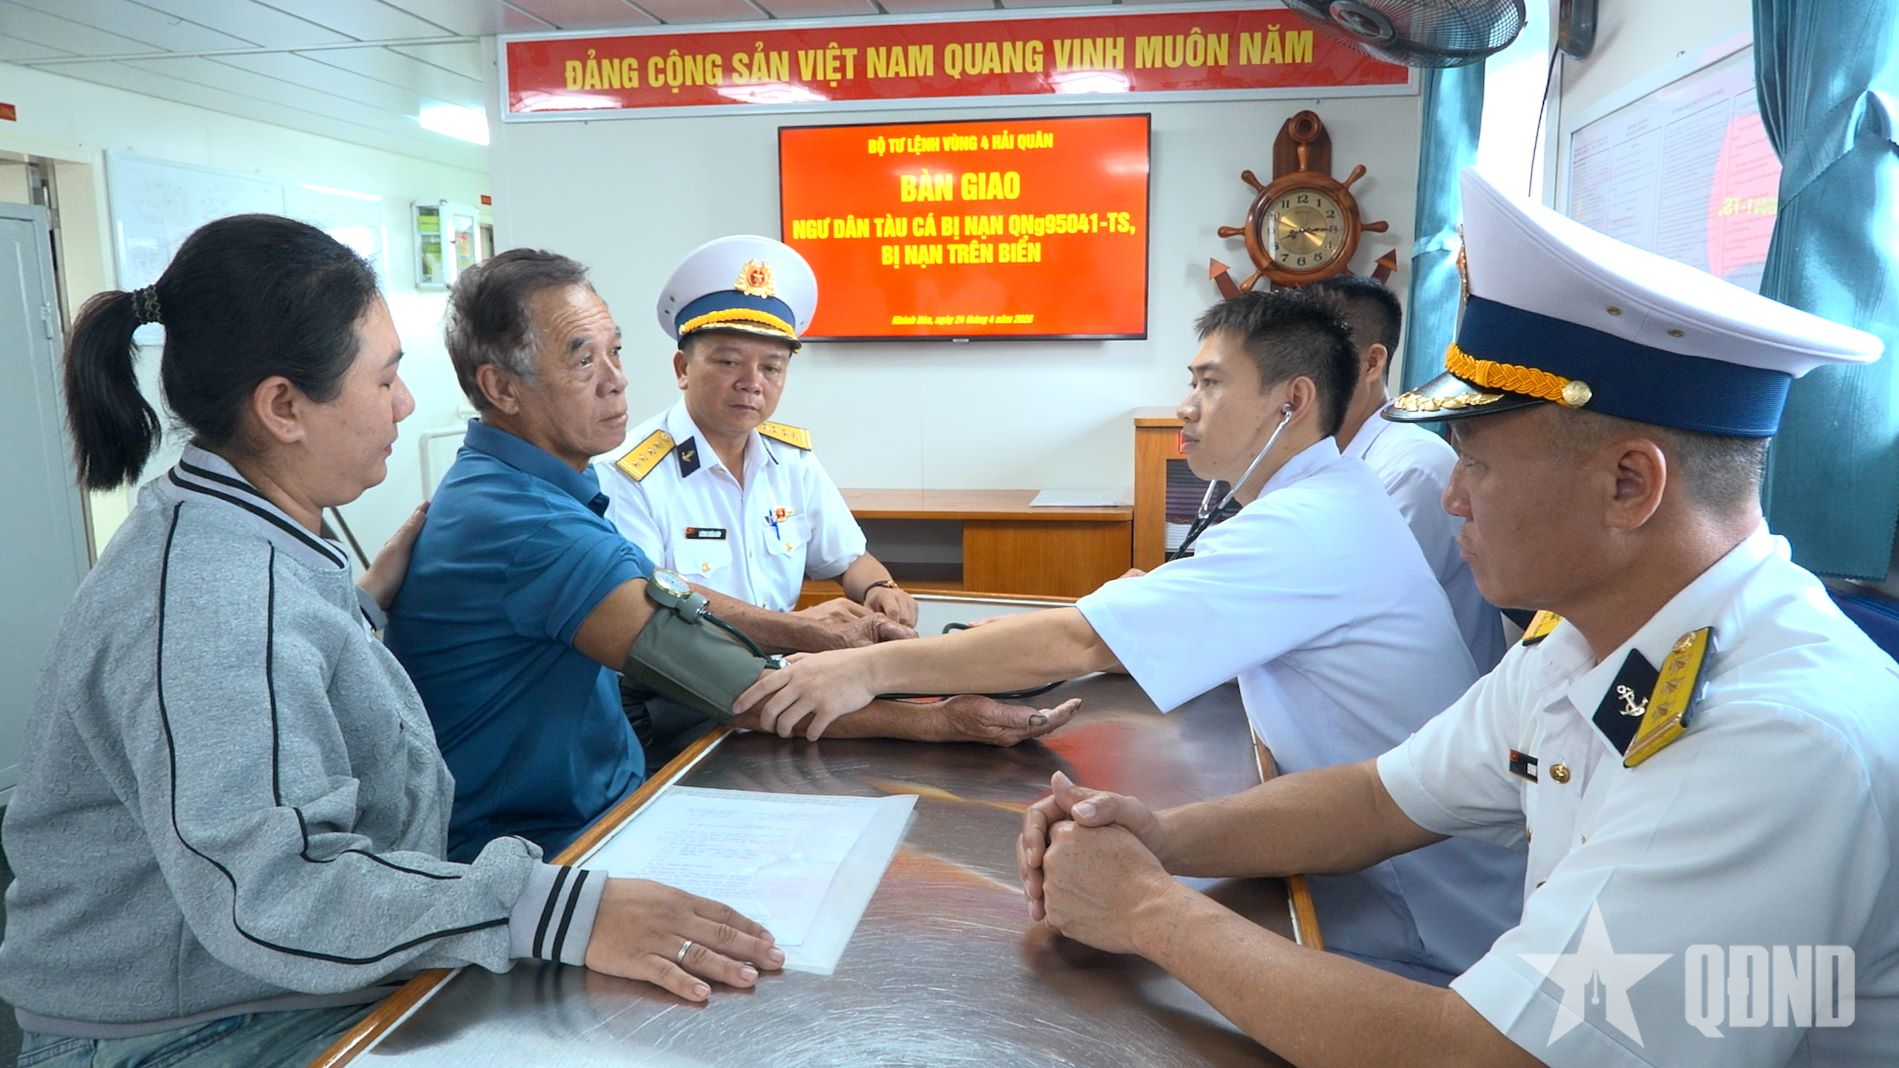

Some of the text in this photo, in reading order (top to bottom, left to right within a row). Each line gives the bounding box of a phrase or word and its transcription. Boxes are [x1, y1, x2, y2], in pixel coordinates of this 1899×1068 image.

[565, 24, 1314, 94] ĐẢNG CỘNG SẢN VIỆT NAM QUANG VINH MUÔN NĂM
[868, 129, 1054, 157] BỘ TƯ LỆNH VÙNG 4 HẢI QUÂN
[900, 168, 1021, 203] BÀN GIAO
[1297, 194, 1309, 204] 12
[1317, 198, 1322, 208] 1
[1281, 200, 1290, 209] 11
[1326, 209, 1336, 219] 2
[792, 212, 1136, 240] NGƯ DÂN TÀU CÁ BỊ NẠN QNg95041-TS,
[881, 235, 1041, 269] BỊ NẠN TRÊN BIỂN
[1280, 253, 1289, 262] 7
[1297, 257, 1306, 266] 6
